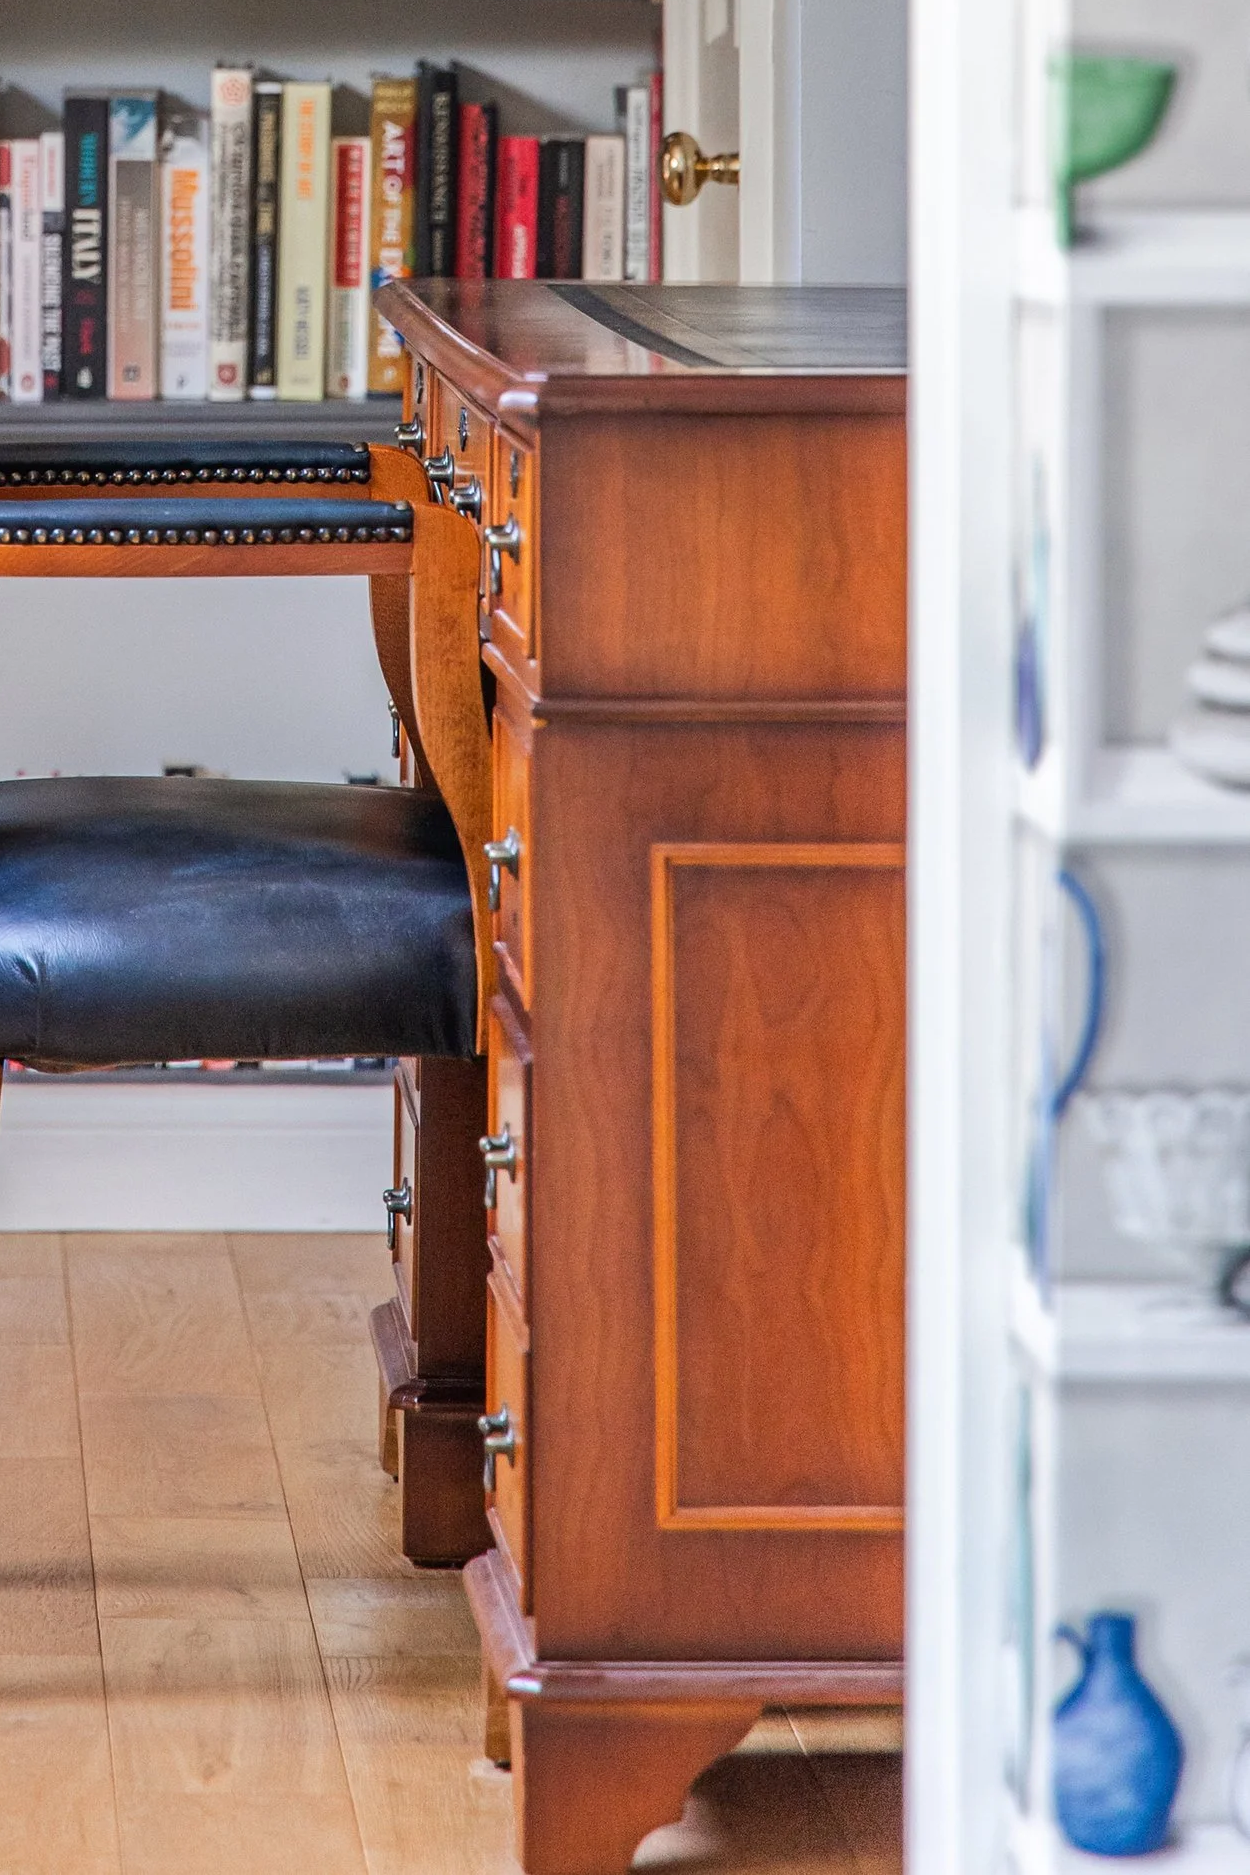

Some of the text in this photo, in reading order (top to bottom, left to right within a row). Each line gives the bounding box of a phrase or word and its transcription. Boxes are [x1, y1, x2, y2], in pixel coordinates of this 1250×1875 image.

[381, 121, 404, 243] ART OF THE
[433, 92, 449, 224] RENAISSANCE
[42, 233, 62, 371] SILENCING THE PAST
[72, 209, 101, 283] ITALY
[170, 168, 199, 311] Mussolini
